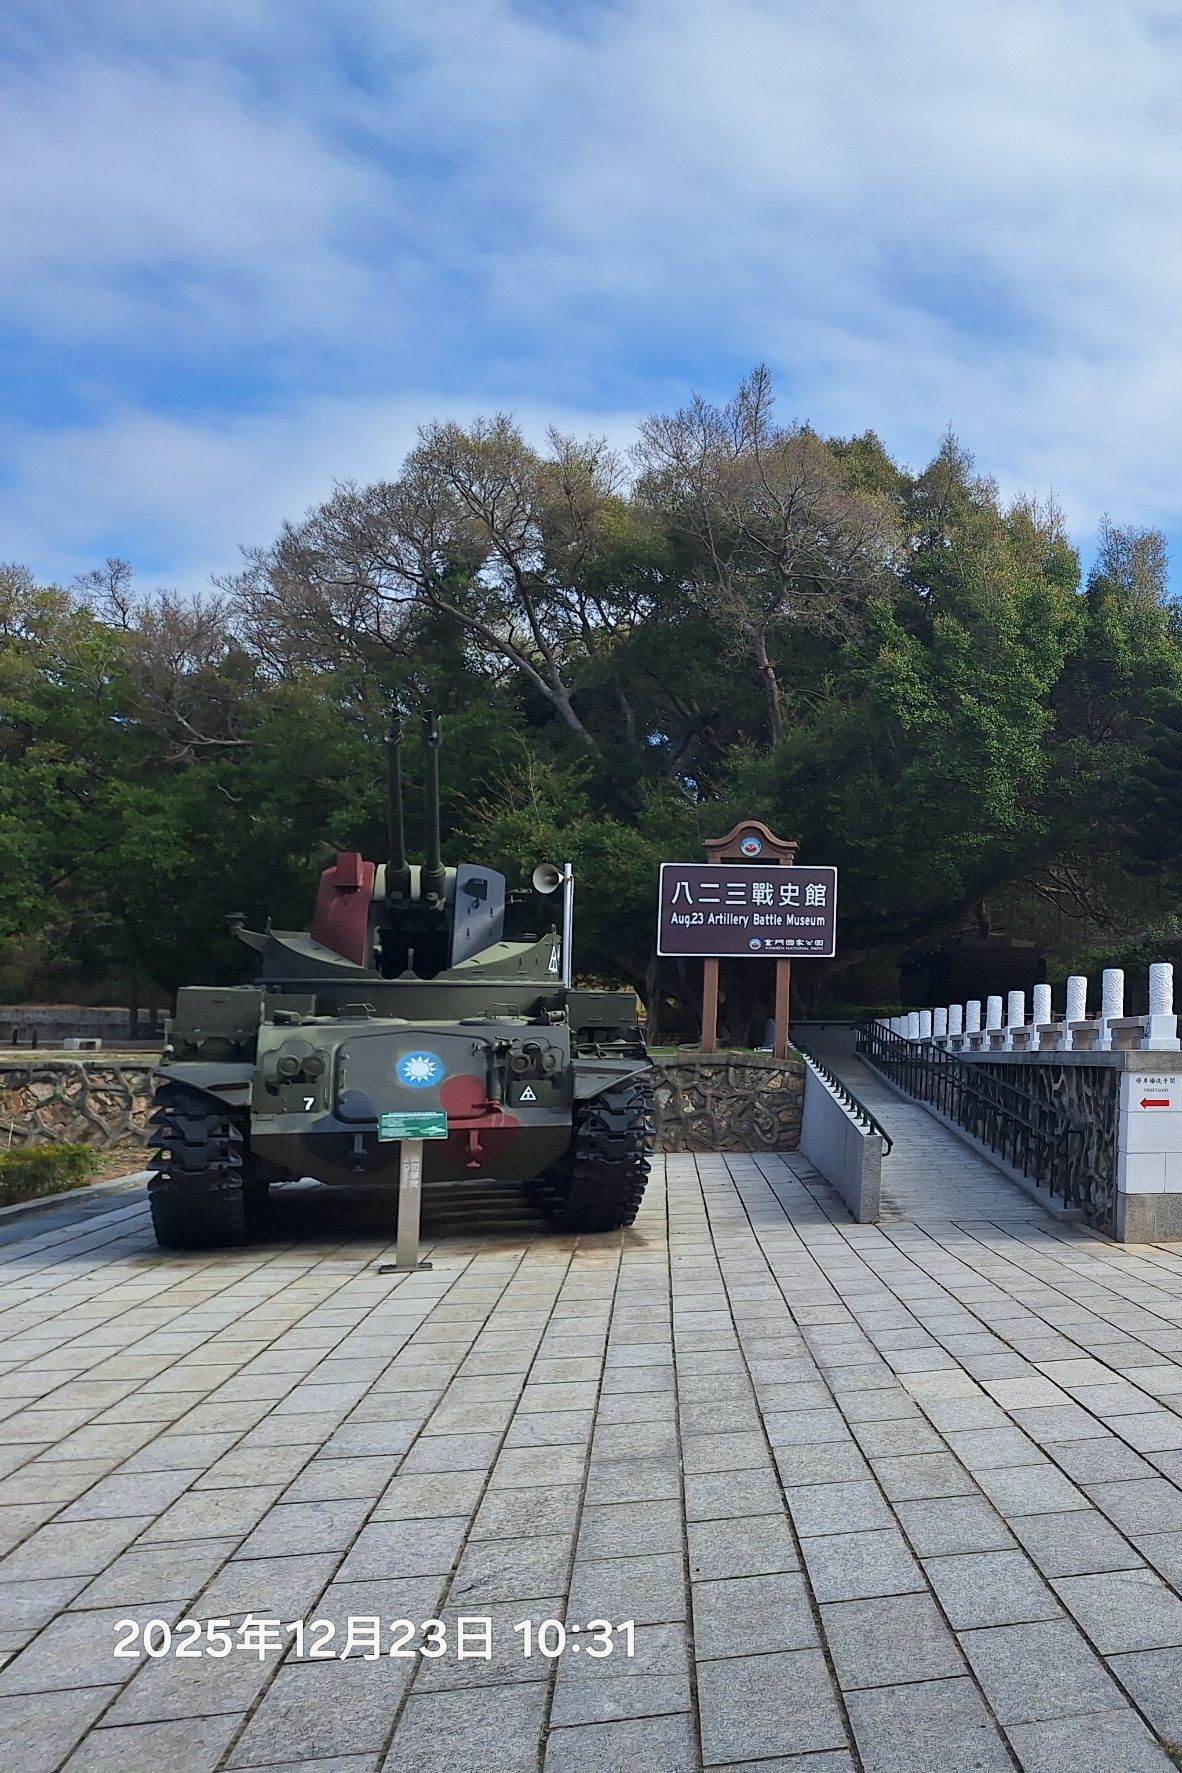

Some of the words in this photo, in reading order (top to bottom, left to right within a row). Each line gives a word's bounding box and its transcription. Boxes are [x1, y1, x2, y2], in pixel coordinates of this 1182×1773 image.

[671, 881, 827, 907] 八二三戰史館
[670, 912, 704, 928] Aug.23
[707, 912, 749, 928] Artillery
[753, 913, 783, 926] Battle
[786, 914, 826, 927] Museum
[303, 1097, 315, 1111] 7
